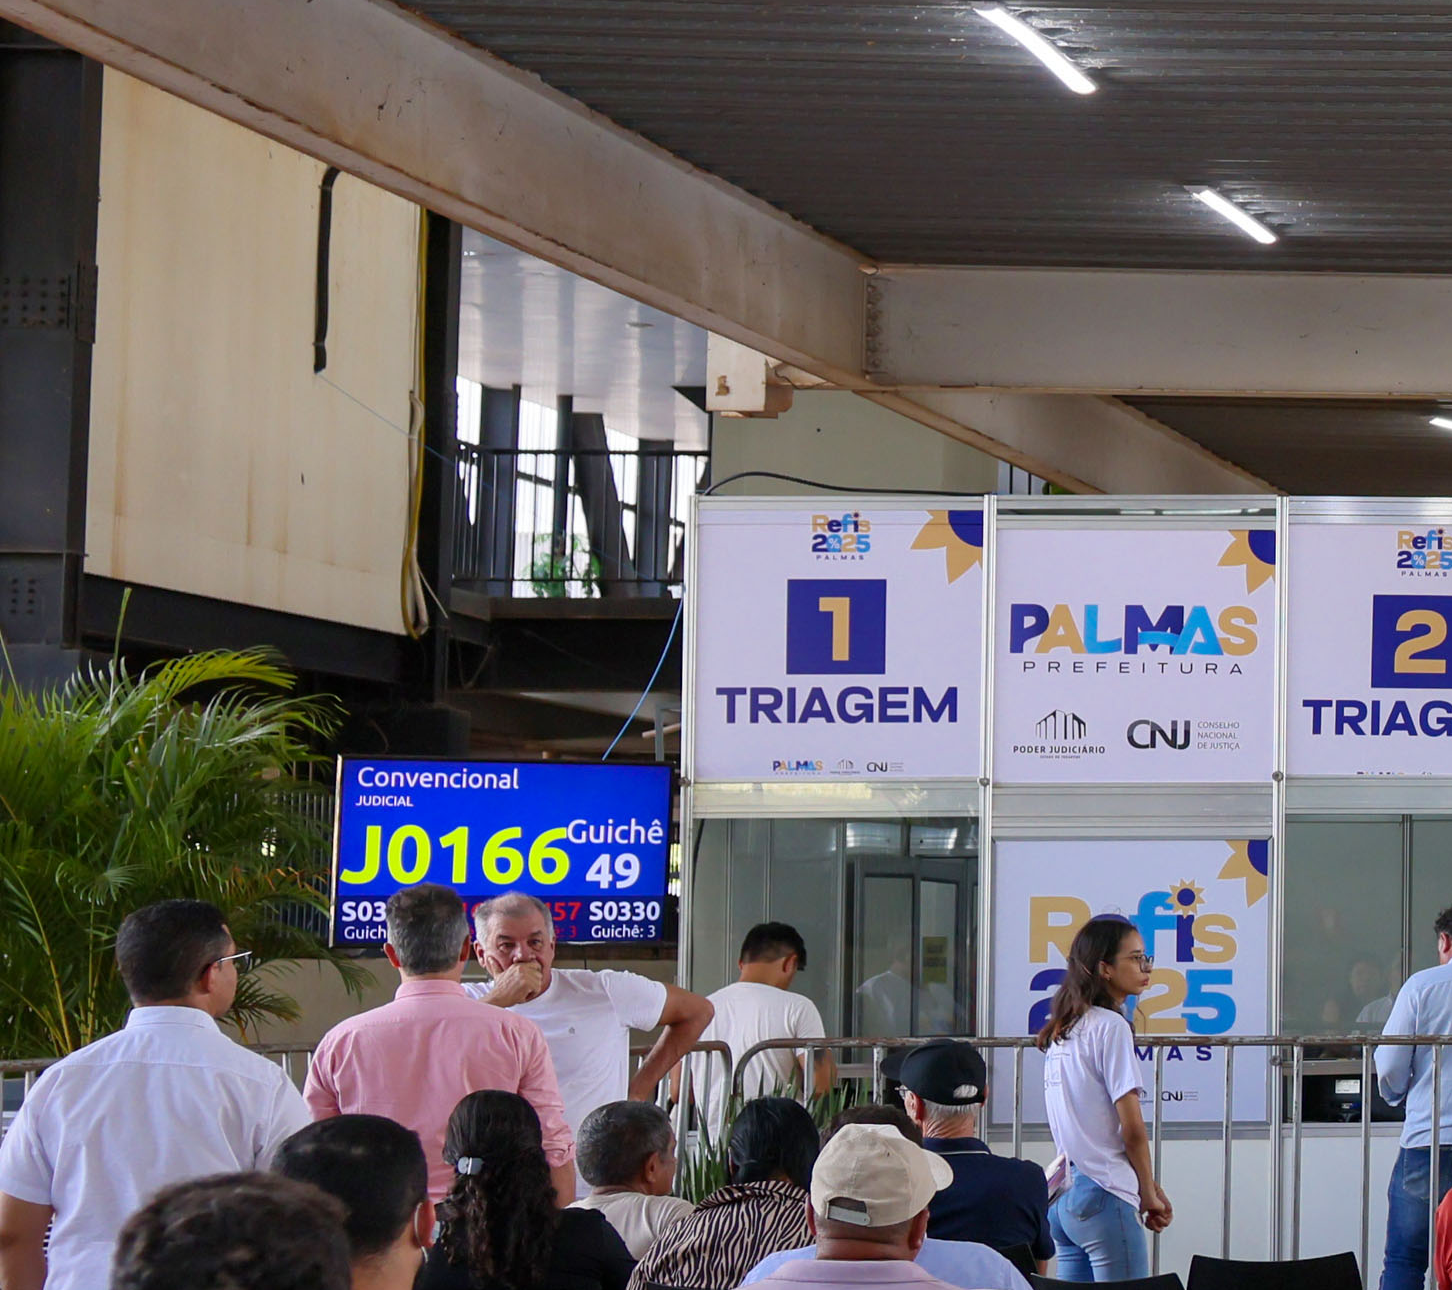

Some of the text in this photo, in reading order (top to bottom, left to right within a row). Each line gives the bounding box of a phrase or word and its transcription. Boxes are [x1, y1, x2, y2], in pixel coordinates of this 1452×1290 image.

[812, 512, 871, 533] Refis
[819, 597, 850, 661] 1
[1010, 604, 1257, 656] PALMAS
[1394, 609, 1447, 673] 2
[1024, 661, 1242, 674] PREFEITURA
[716, 687, 957, 723] TRIAGEM
[1127, 720, 1191, 750] CNJ
[1198, 721, 1239, 729] CONSELHO
[1013, 744, 1105, 754] PODER JUDICIÁRIO
[1209, 742, 1240, 751] JUSTIÇA
[773, 760, 823, 771] PALMAS
[867, 762, 888, 772] CNJ
[358, 767, 519, 789] Convencional
[356, 796, 413, 807] JUDICIAL
[340, 819, 663, 884] J0166 Guichê
[586, 853, 640, 889] 49
[342, 902, 387, 921] S03
[589, 902, 660, 920] S0330
[1029, 878, 1237, 963] Rfis
[591, 925, 655, 938] Guichê: 3
